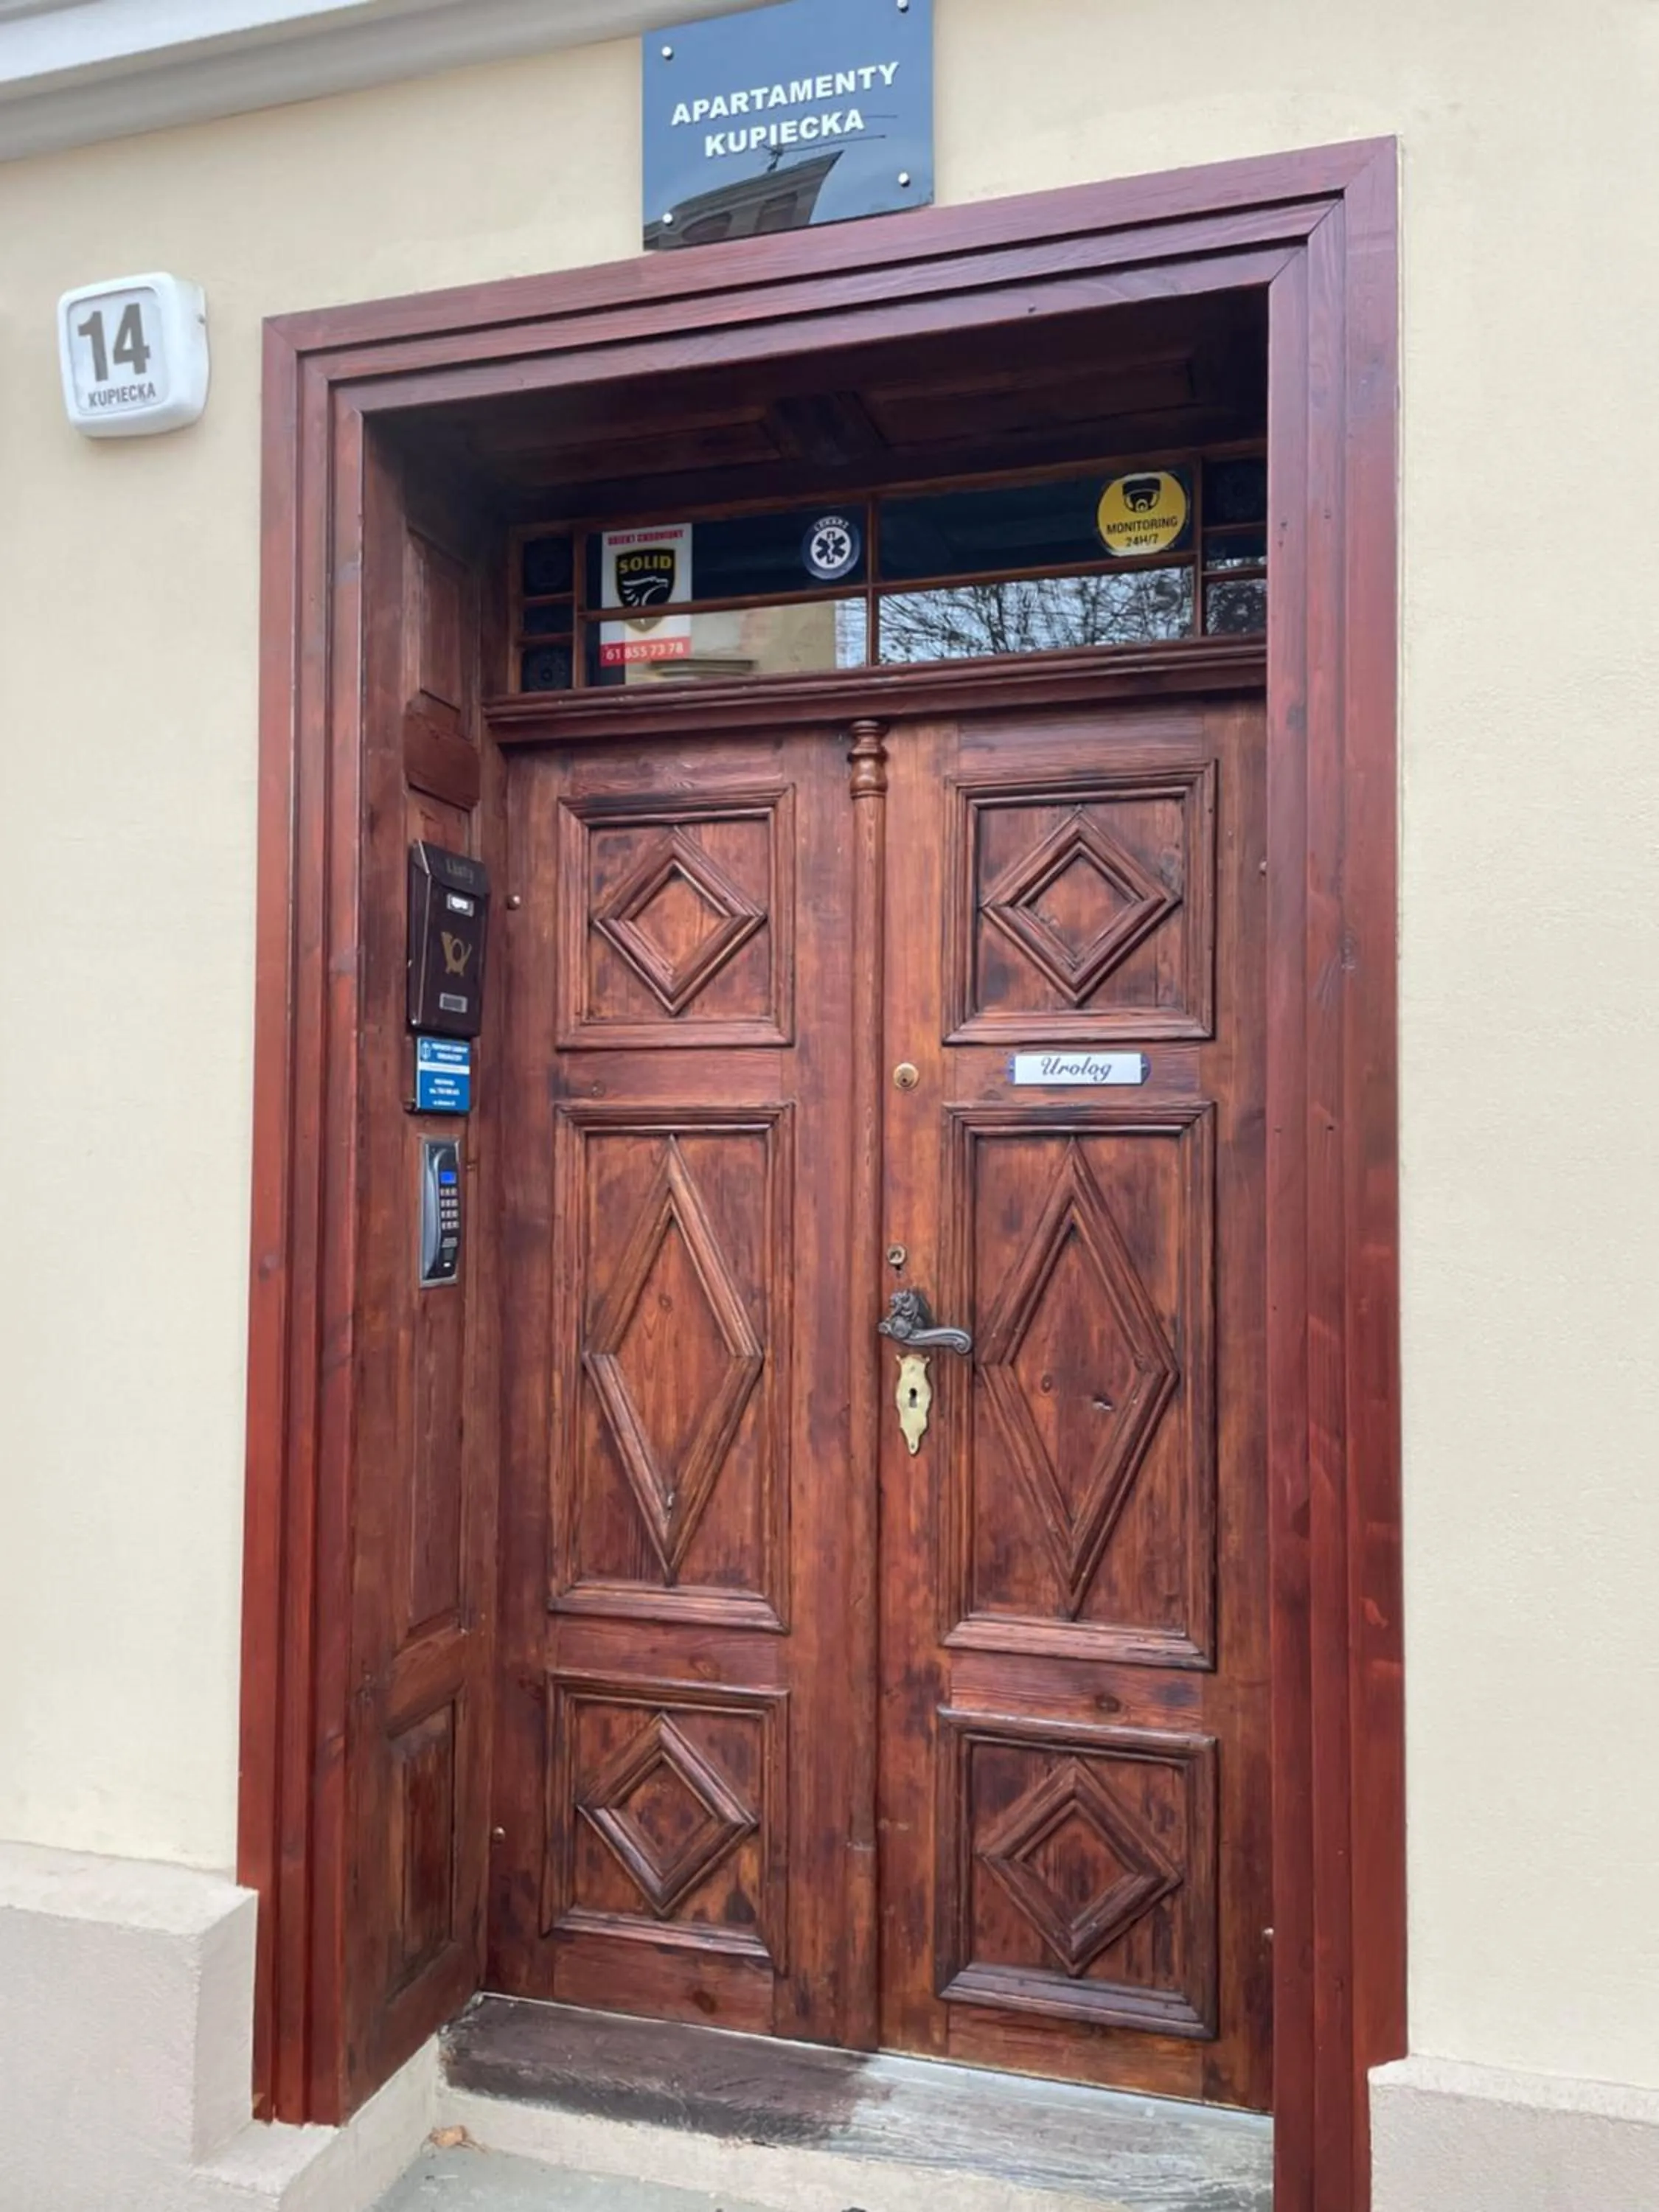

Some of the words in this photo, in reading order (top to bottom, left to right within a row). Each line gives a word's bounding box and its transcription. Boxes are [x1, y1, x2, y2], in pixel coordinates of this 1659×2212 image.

[671, 62, 899, 125] APARTAMENTY
[705, 110, 865, 157] KUPIECKA
[77, 302, 150, 382] 14
[88, 382, 156, 408] KUPIECKA
[1107, 515, 1178, 534] MONITORING
[619, 555, 672, 574] SOLID
[605, 648, 621, 661] 61
[1040, 1056, 1112, 1082] Urolog
